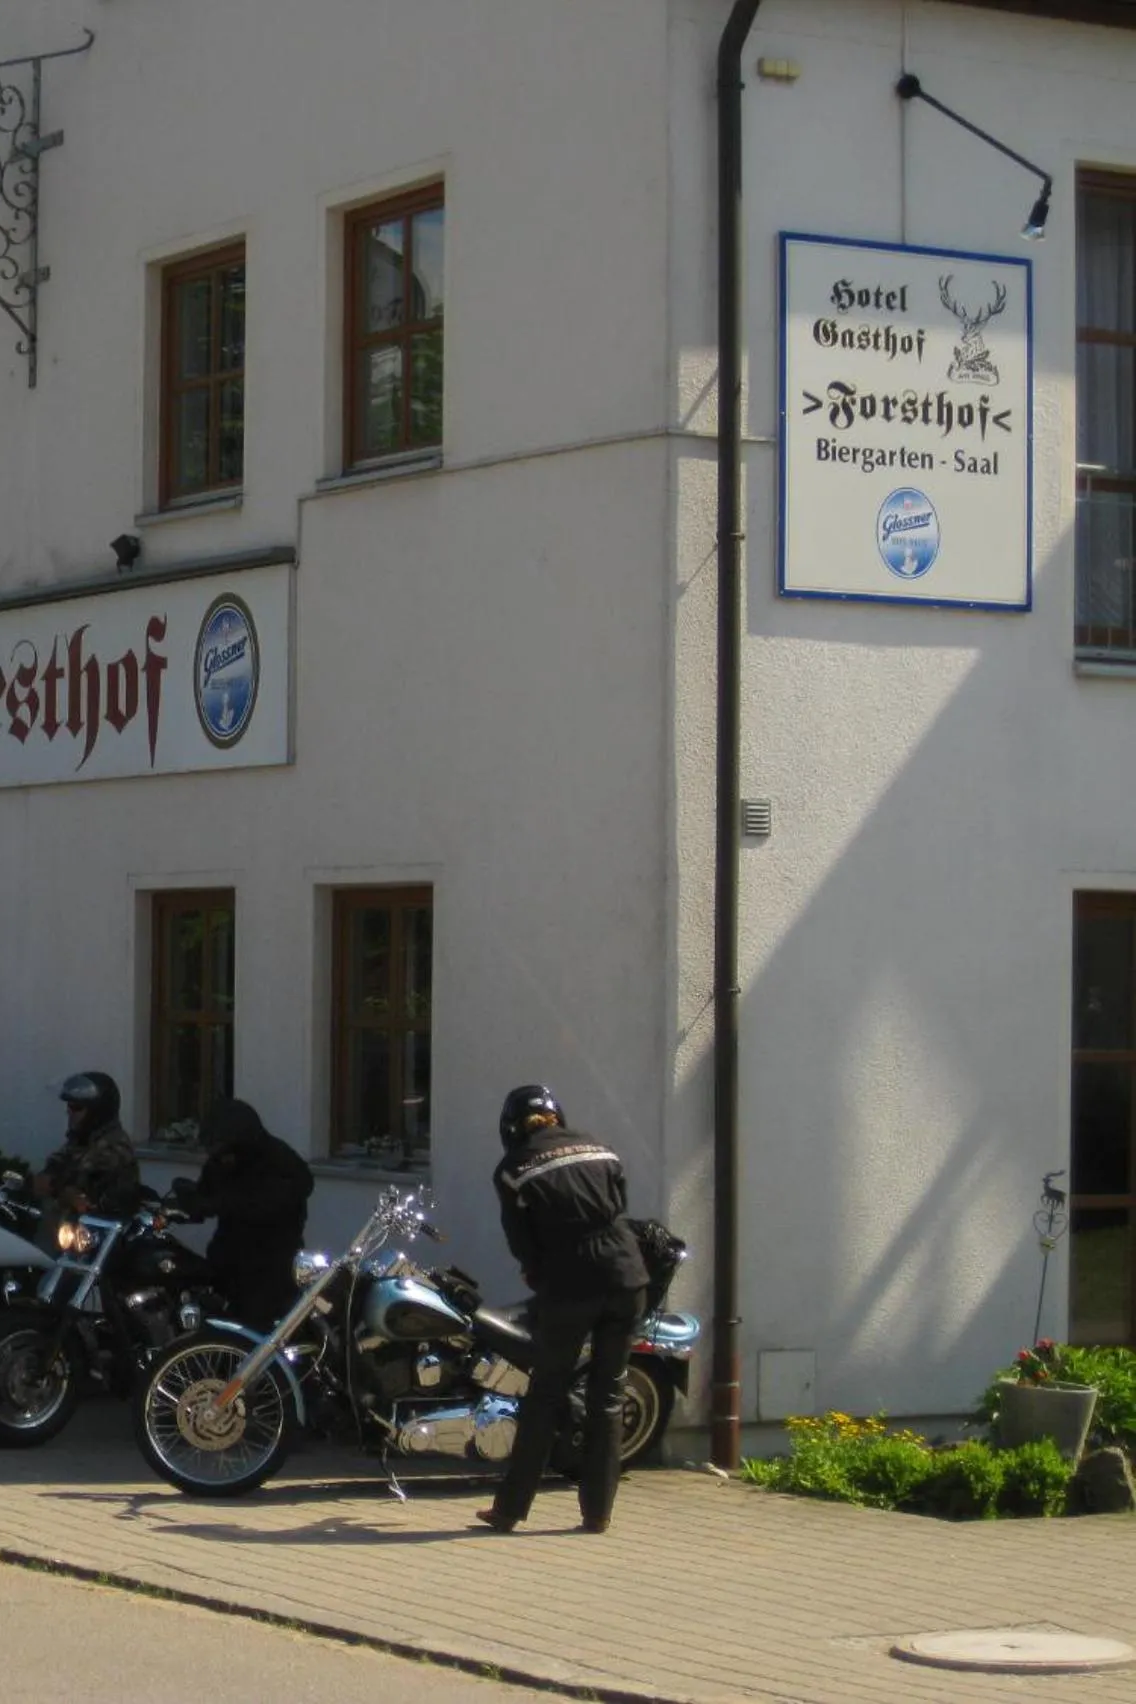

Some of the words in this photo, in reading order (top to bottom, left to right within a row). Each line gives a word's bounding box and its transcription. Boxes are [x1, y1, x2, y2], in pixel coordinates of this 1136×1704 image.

[830, 278, 908, 314] Hotel
[813, 317, 926, 364] Gasthof
[816, 437, 934, 473] Biergarten
[954, 450, 999, 475] Saal
[882, 512, 933, 542] Glossner
[204, 636, 248, 688] Glossner
